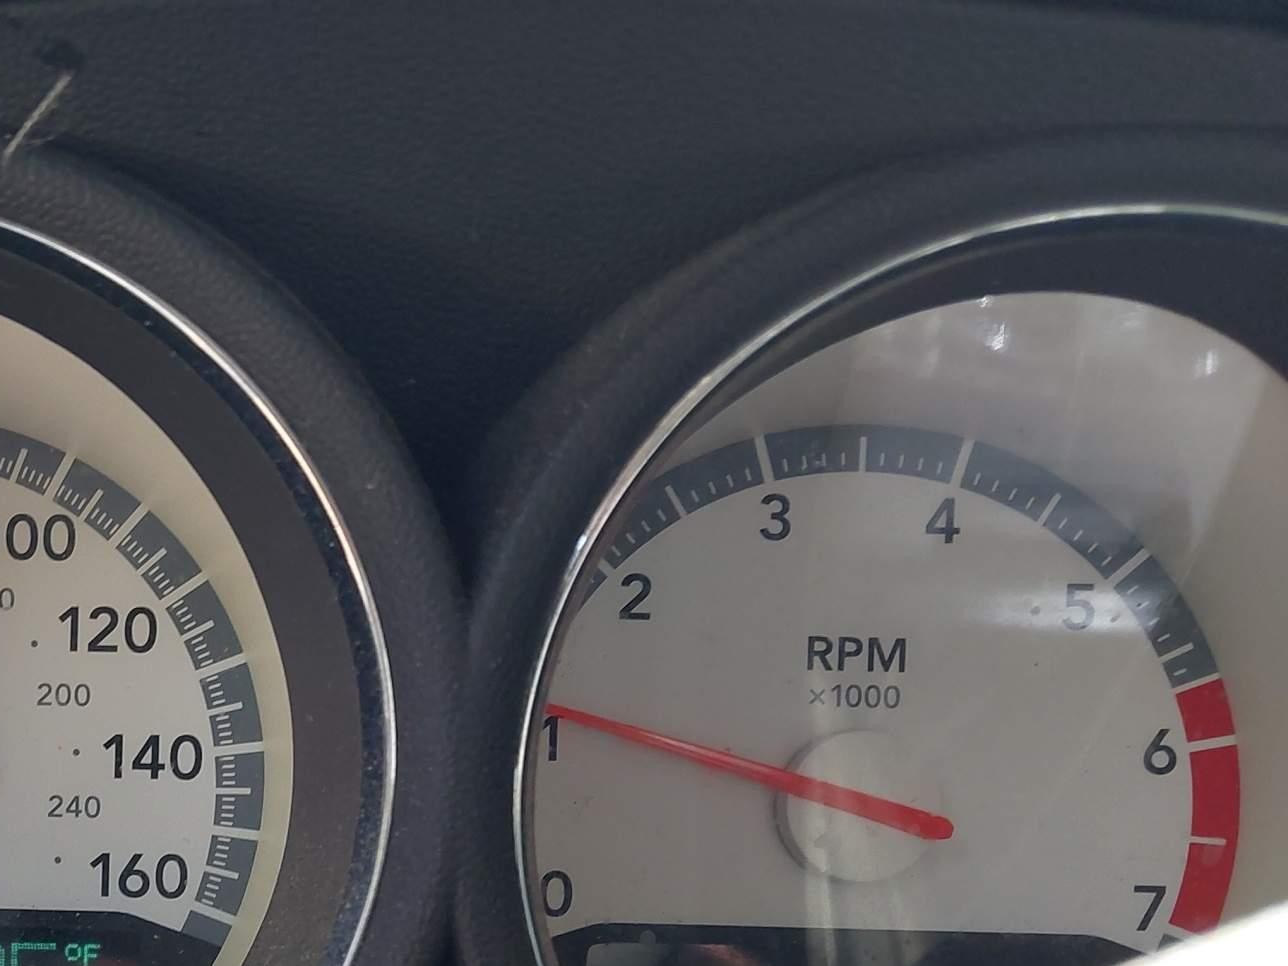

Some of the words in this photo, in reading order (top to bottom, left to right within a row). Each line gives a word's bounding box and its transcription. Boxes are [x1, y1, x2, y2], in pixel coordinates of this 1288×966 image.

[759, 493, 791, 541] 3
[925, 497, 961, 544] 4
[618, 573, 652, 621] 2
[1062, 583, 1095, 631] 5
[58, 605, 158, 654] 120
[807, 635, 907, 674] RPM
[36, 683, 91, 707] 200
[103, 733, 203, 781] 140
[542, 713, 560, 762] 1
[1143, 728, 1177, 776] 6
[47, 795, 101, 819] 240
[89, 852, 188, 899] 160
[541, 869, 573, 918] 0
[1133, 885, 1167, 932] 7
